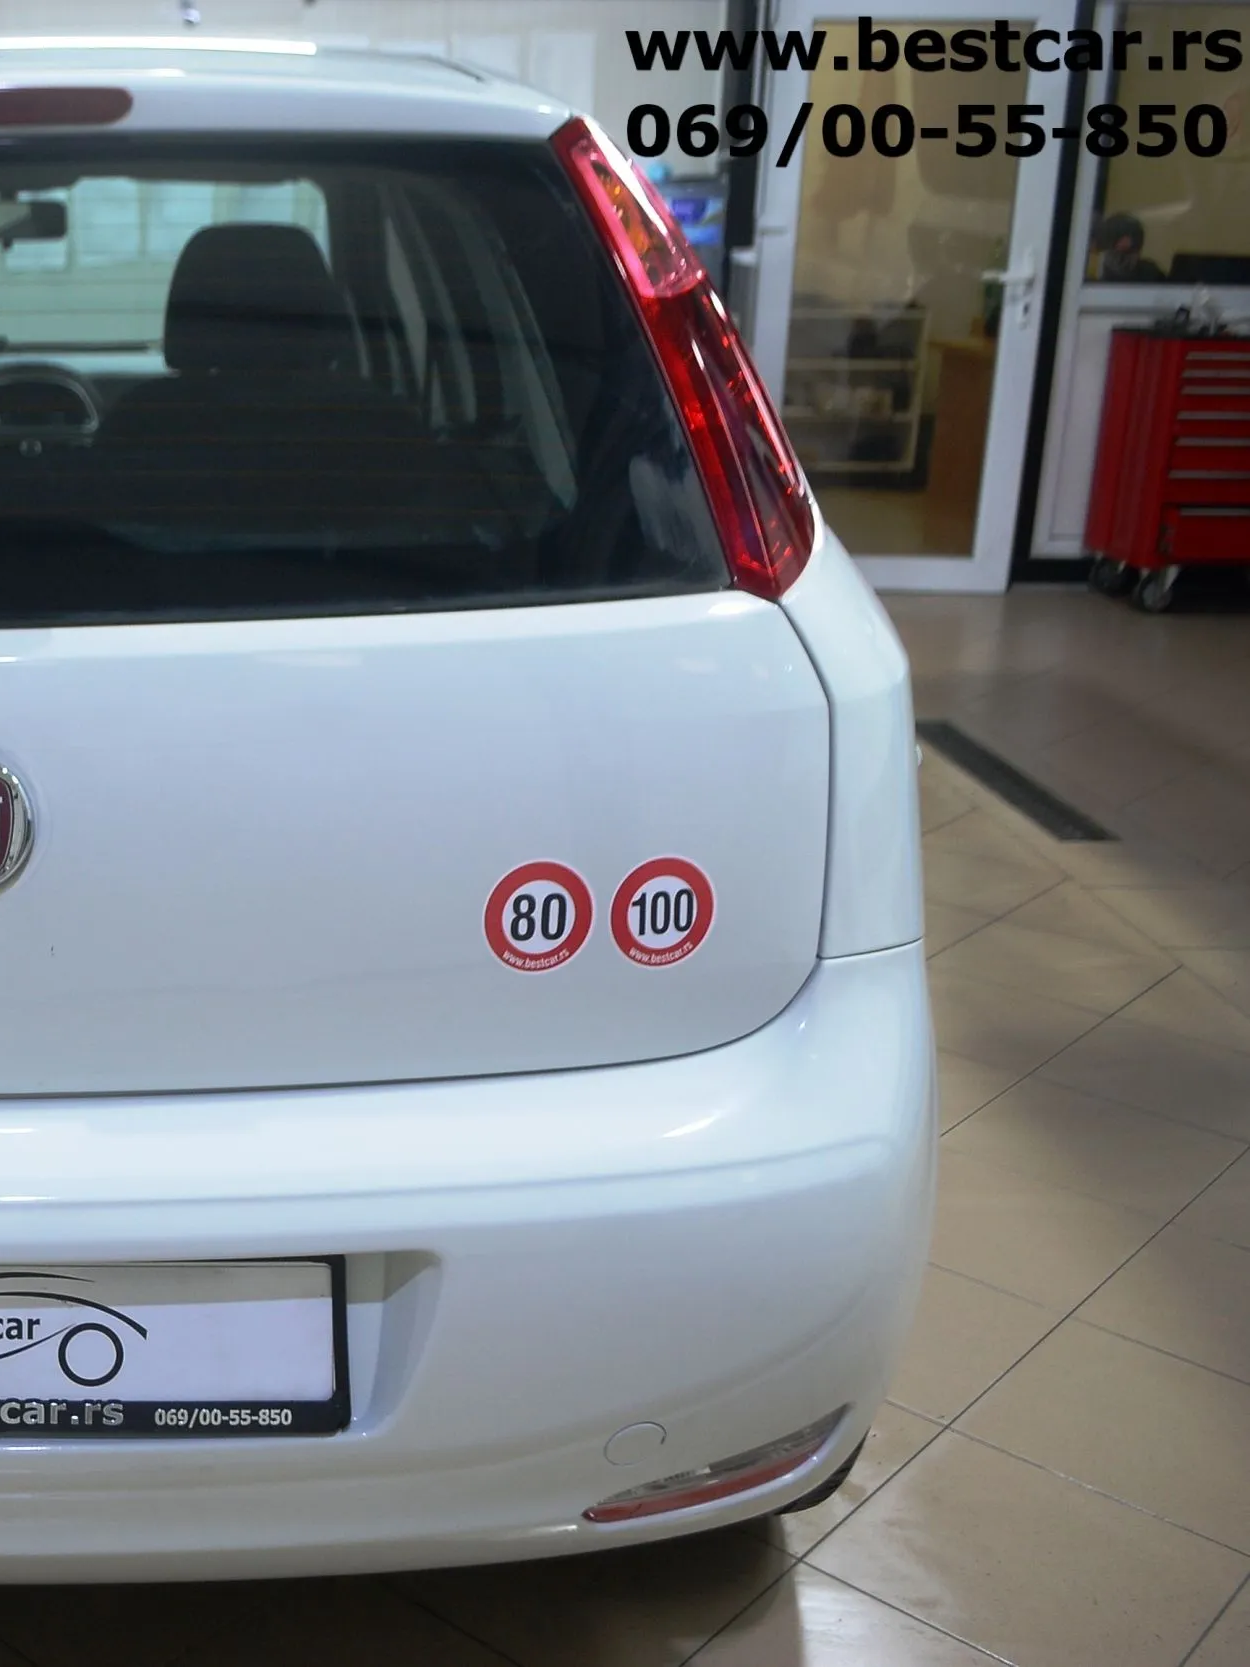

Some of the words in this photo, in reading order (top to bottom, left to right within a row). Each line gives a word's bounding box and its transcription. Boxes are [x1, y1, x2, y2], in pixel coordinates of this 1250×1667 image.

[510, 893, 567, 941] 80
[632, 888, 694, 936] 100
[502, 949, 570, 969] www.bestcar.rs
[628, 942, 694, 964] www.bestcar.rs
[154, 1408, 293, 1428] 069/00-55-850
